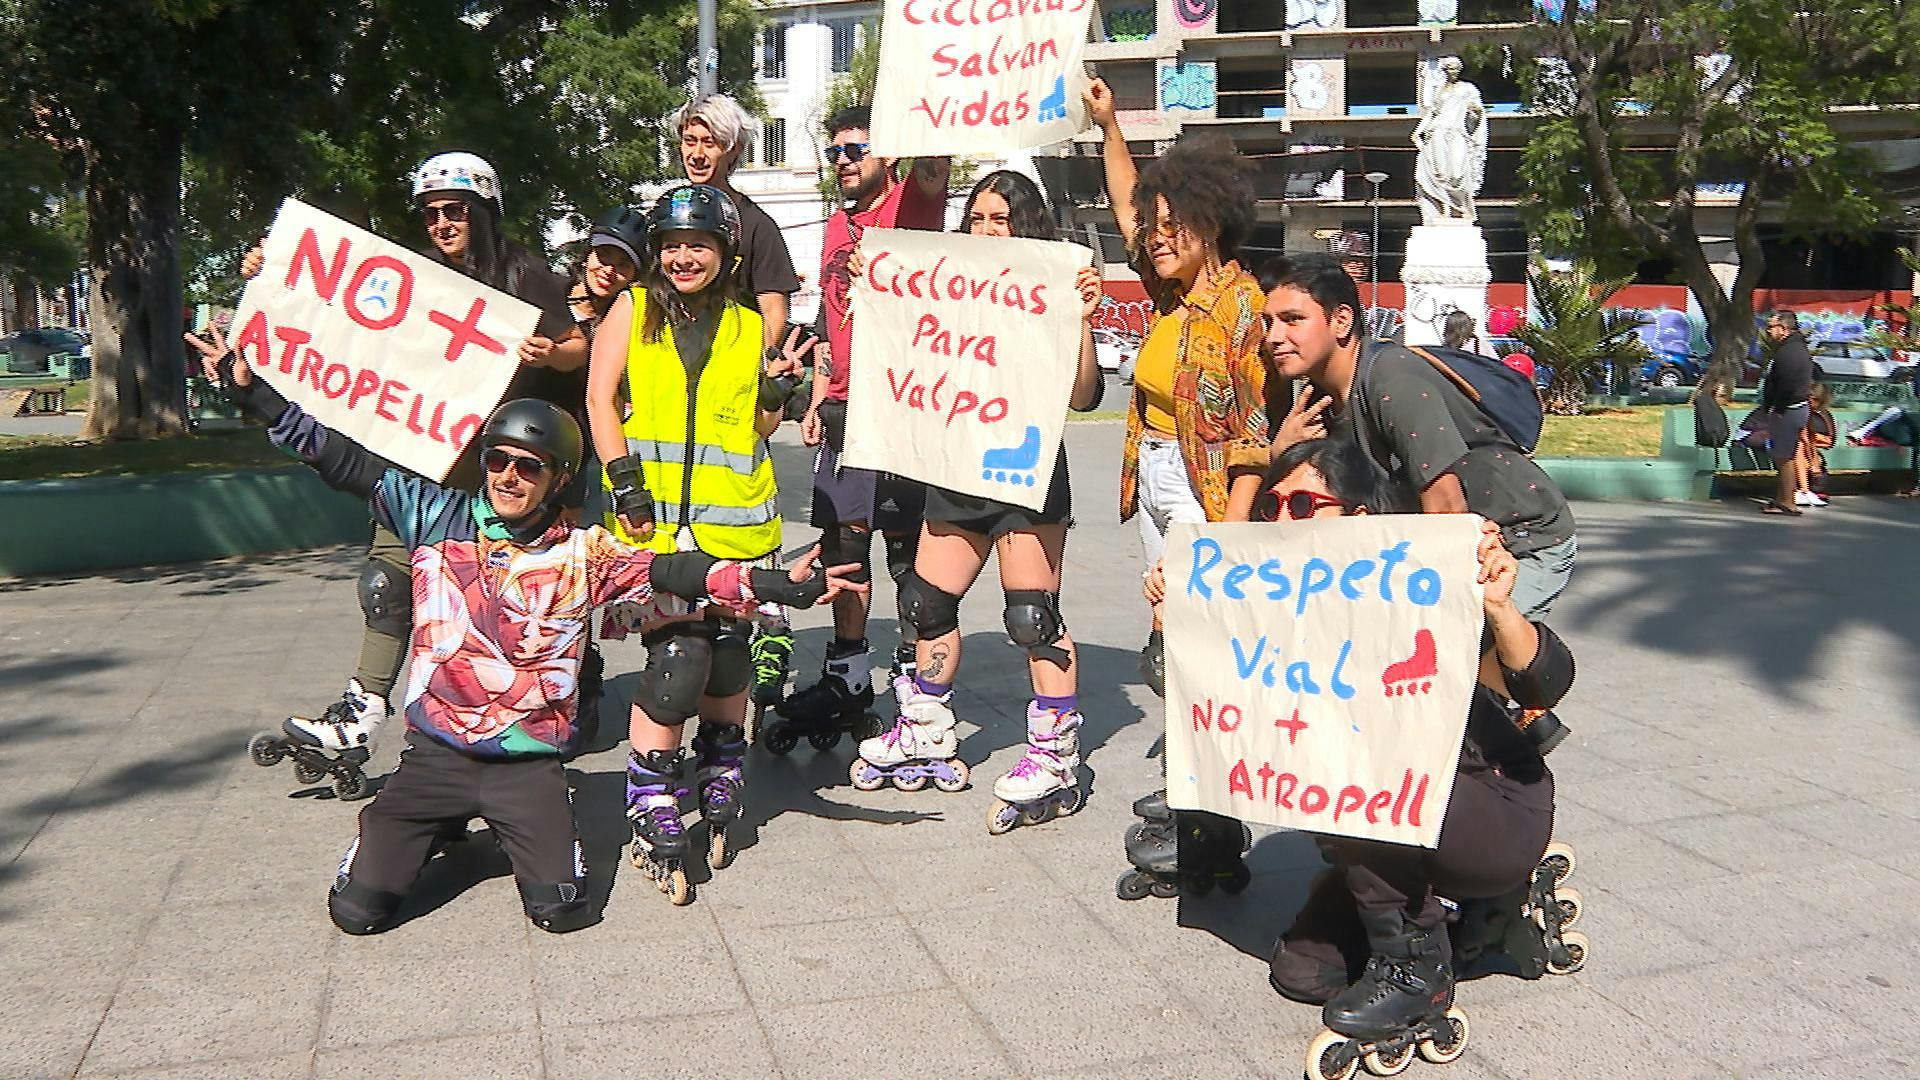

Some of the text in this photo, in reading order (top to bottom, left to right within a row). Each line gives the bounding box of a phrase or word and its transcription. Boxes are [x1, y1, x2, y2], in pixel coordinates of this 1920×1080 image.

[932, 34, 1059, 77] Salvan
[910, 90, 1030, 129] Vidas
[284, 227, 508, 362] NO +
[868, 251, 1047, 316] Ciclovías
[912, 313, 997, 368] Para
[887, 367, 1009, 429] Valpo
[1187, 537, 1442, 617] Respeto
[1231, 635, 1357, 701] Vial
[1192, 698, 1309, 745] NO +
